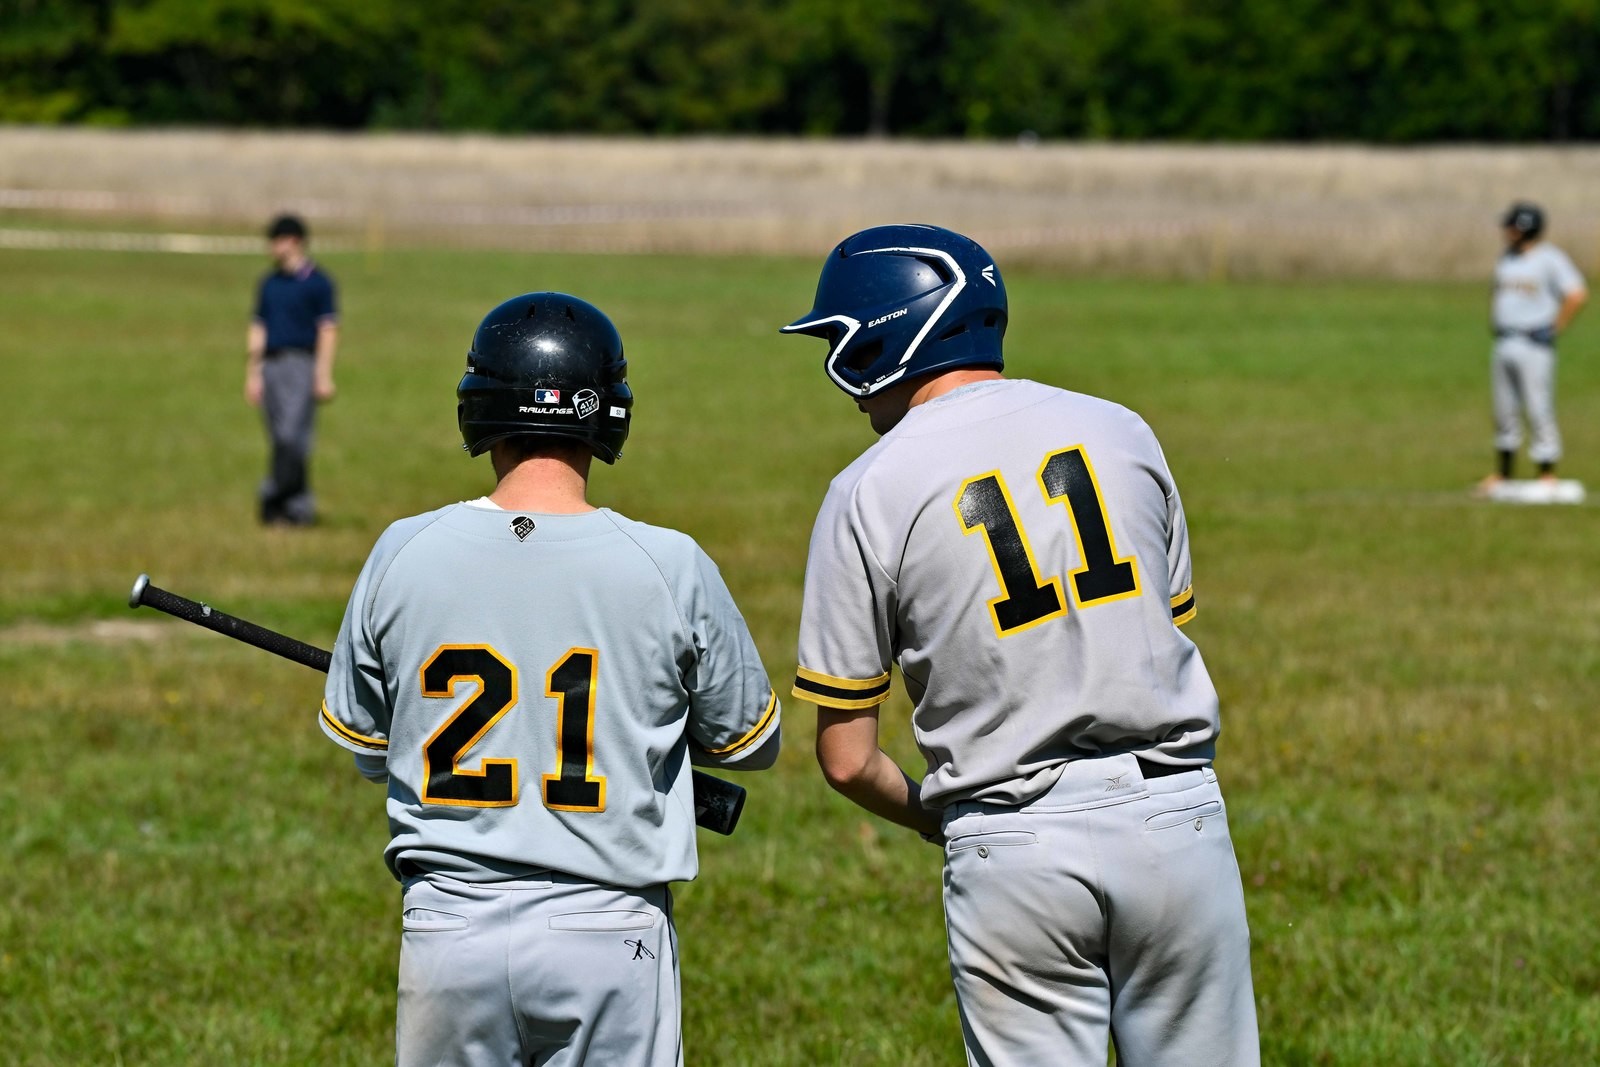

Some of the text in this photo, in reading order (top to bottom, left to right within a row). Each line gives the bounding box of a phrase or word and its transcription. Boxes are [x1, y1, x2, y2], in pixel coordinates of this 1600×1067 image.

[868, 308, 908, 328] EASTON
[519, 406, 574, 415] RAWLINGS
[580, 398, 594, 410] 417
[517, 519, 531, 534] 417
[952, 443, 1143, 639] 11
[419, 643, 607, 813] 21
